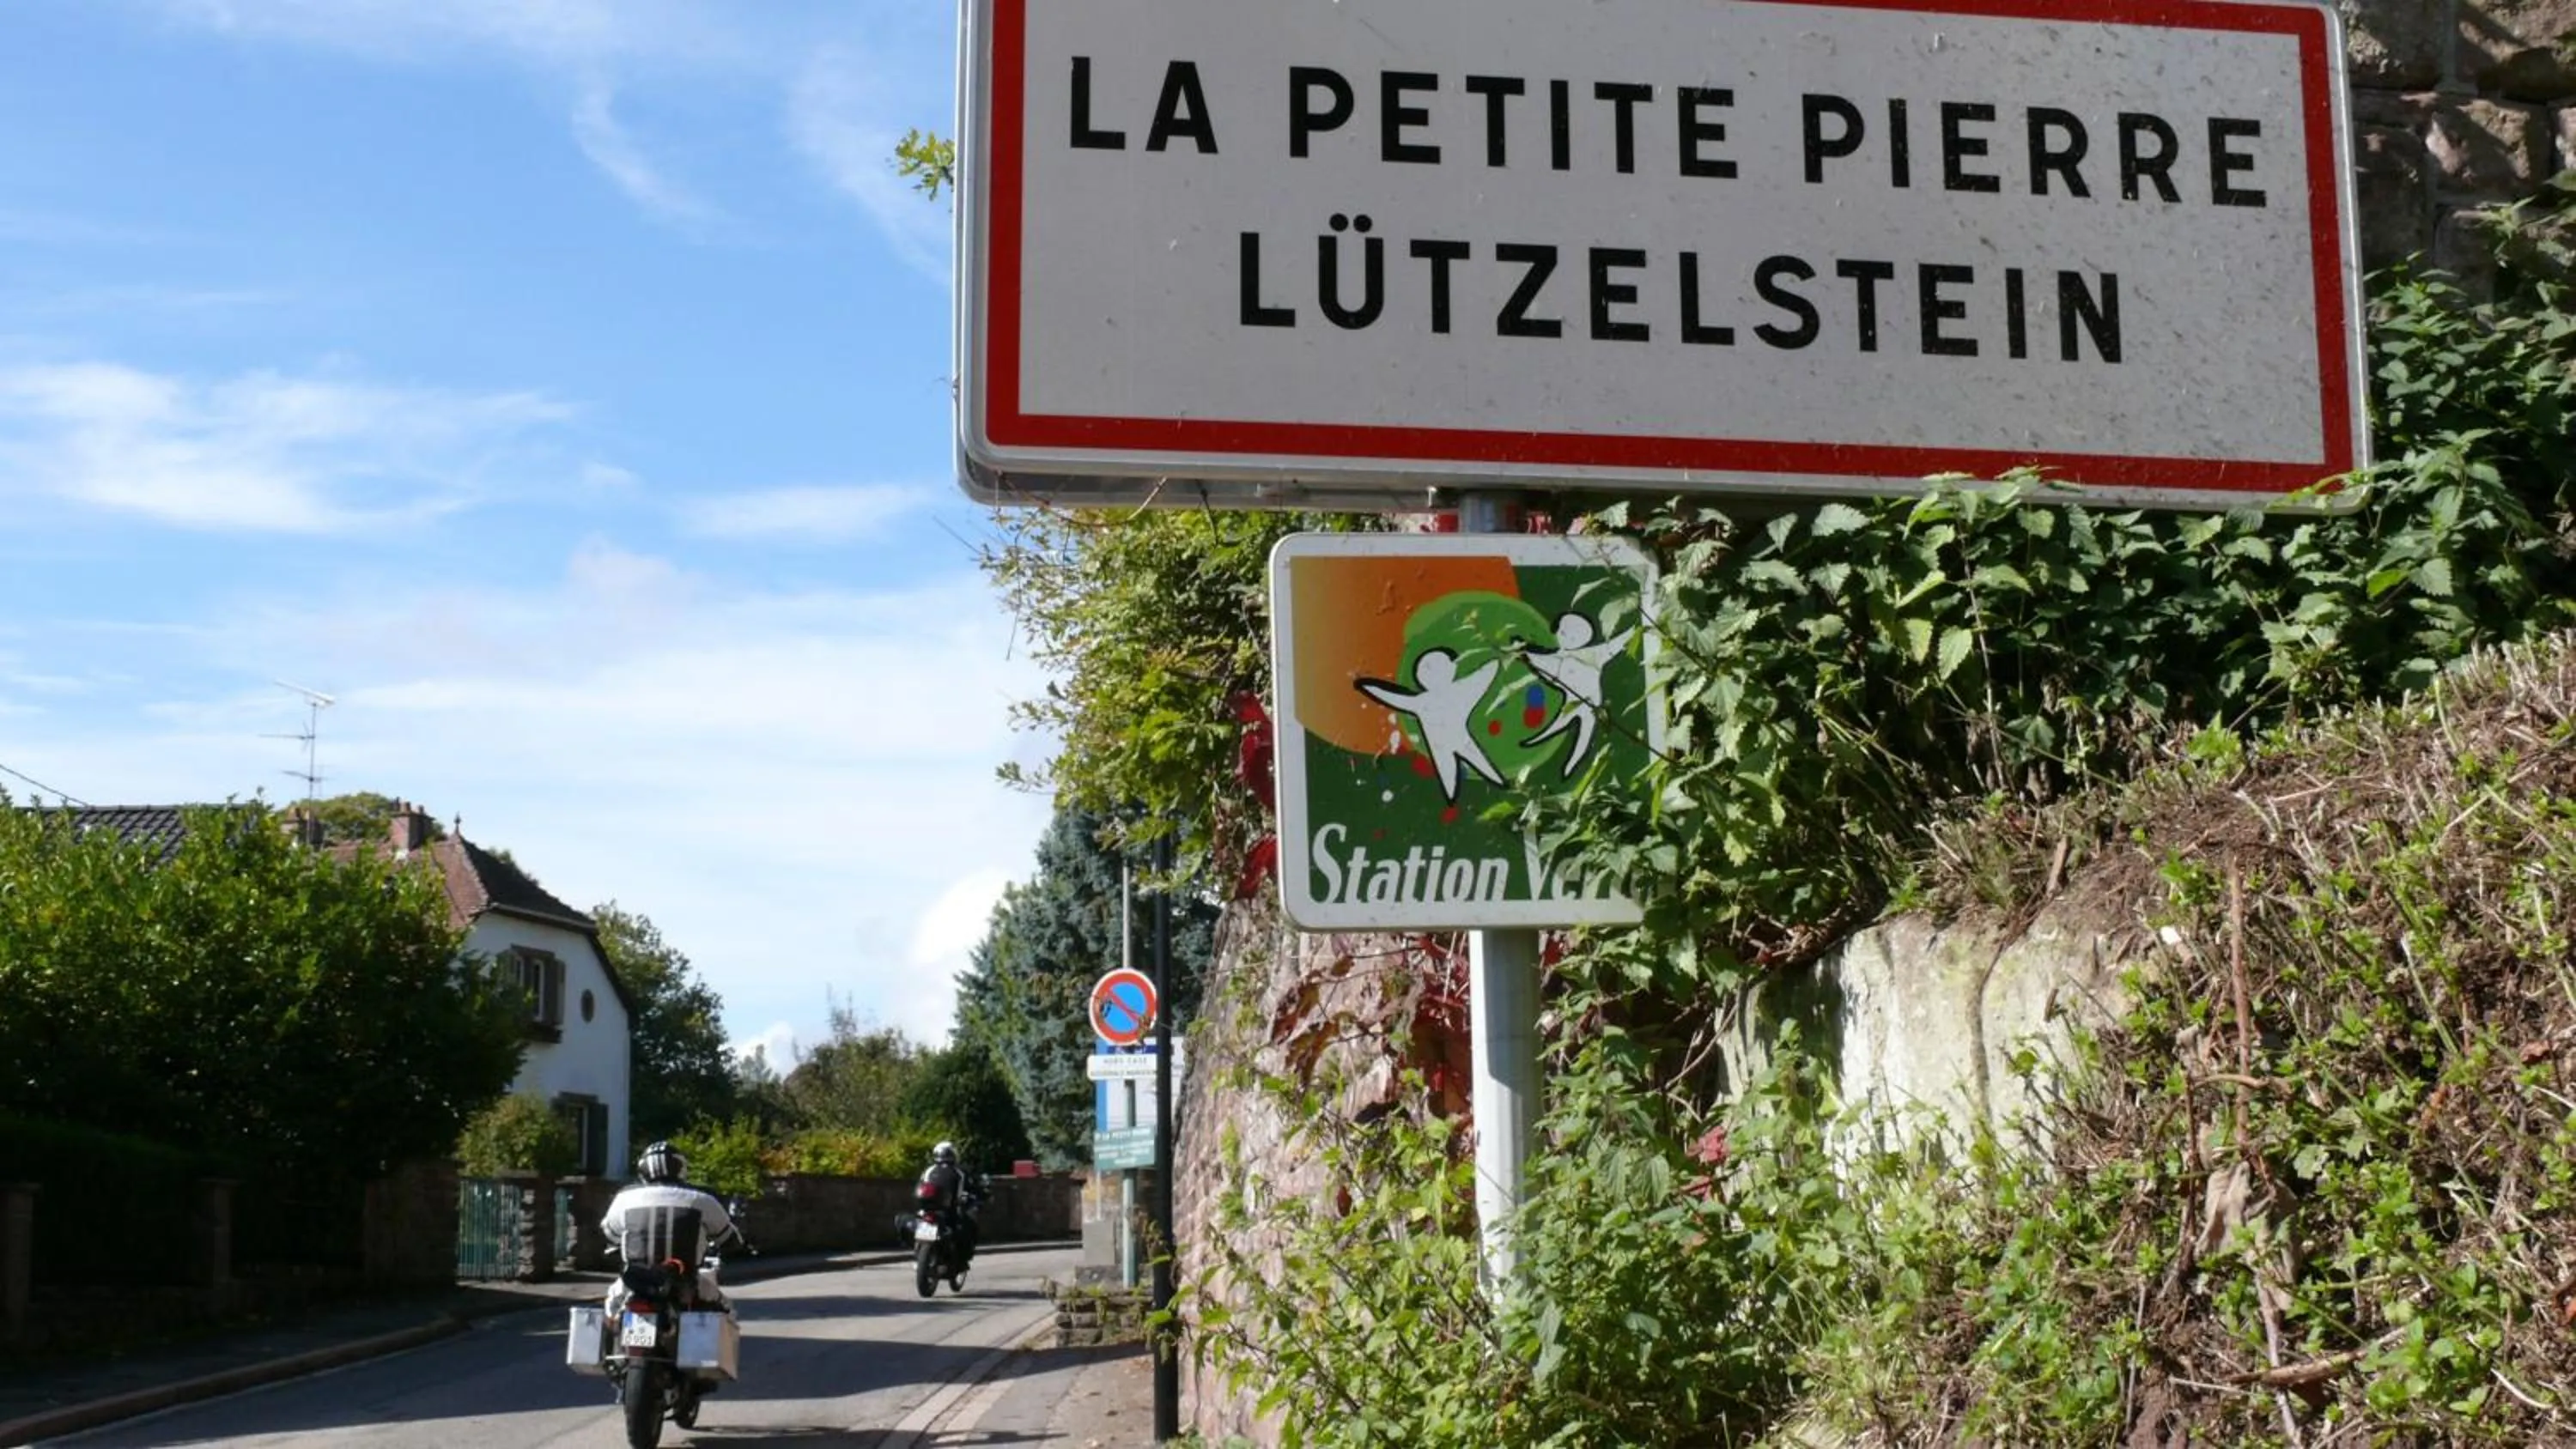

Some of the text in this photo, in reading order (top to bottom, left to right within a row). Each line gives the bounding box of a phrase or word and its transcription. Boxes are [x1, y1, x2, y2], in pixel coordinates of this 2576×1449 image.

[1070, 56, 2267, 208] LA PETITE PIERRE
[1240, 213, 2123, 364] LÜTZELSTEIN
[1310, 823, 1510, 904] Station
